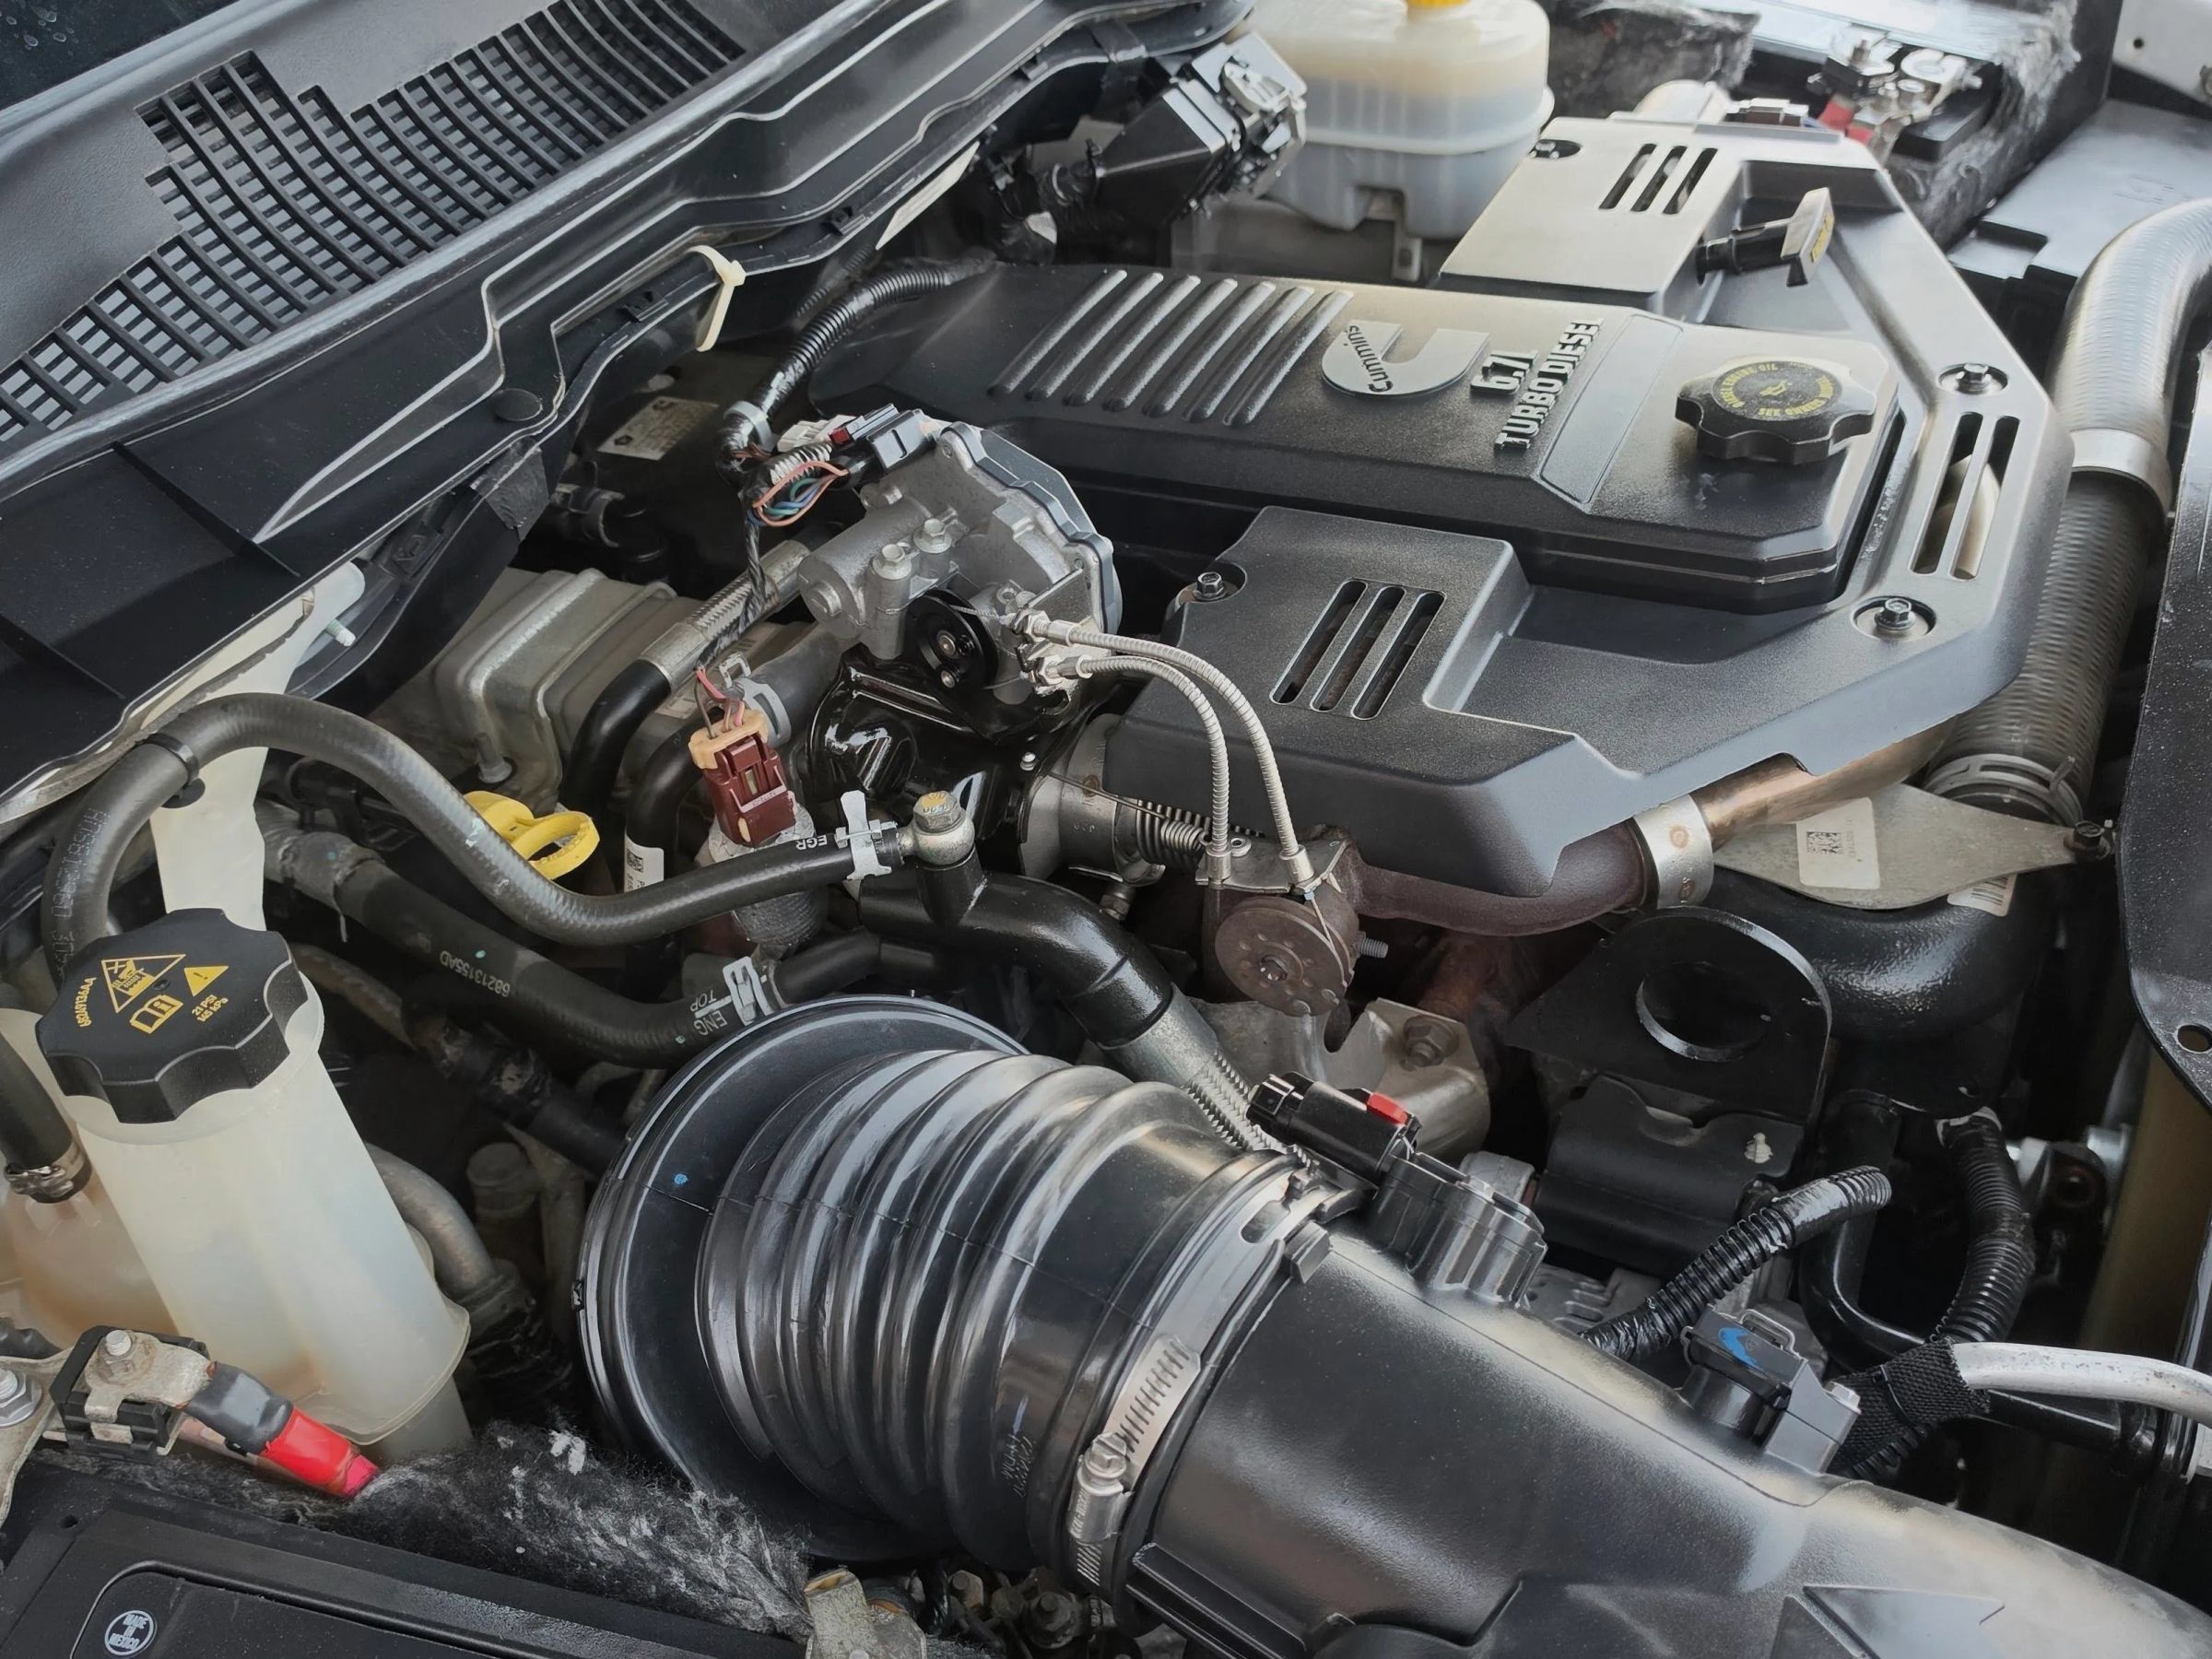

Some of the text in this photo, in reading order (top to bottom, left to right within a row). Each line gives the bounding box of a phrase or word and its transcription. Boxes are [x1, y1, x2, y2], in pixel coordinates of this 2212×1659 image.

[1344, 324, 1394, 393] Cummins
[1759, 363, 1779, 371] OIL
[1472, 350, 1540, 394] 6.7L
[1495, 319, 1604, 451] TURBO DIESEL
[795, 835, 828, 850] EGR
[439, 950, 512, 997] 68213155AD
[192, 994, 218, 1017] 21 PSI
[689, 989, 717, 1013] TOP
[693, 1012, 728, 1037] ENG
[123, 1614, 149, 1630] MADE
[109, 1633, 140, 1651] MEXICO
